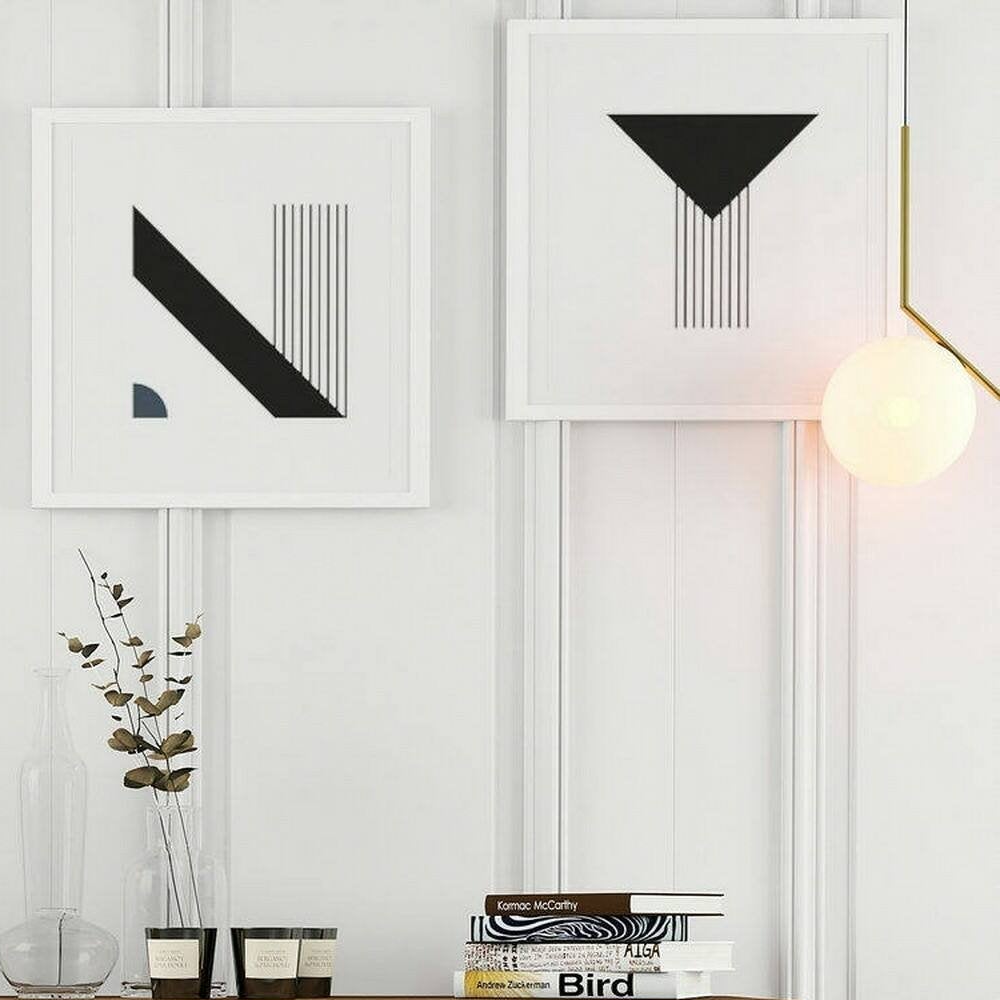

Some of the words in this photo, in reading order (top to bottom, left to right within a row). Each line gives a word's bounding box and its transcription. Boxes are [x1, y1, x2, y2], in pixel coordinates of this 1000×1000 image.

[497, 901, 531, 911] Kormac
[534, 900, 578, 911] McCarthy
[624, 944, 660, 958] AIGA
[476, 980, 506, 990] Andrew
[507, 980, 551, 990] Zuckerman
[558, 973, 634, 997] Bird
